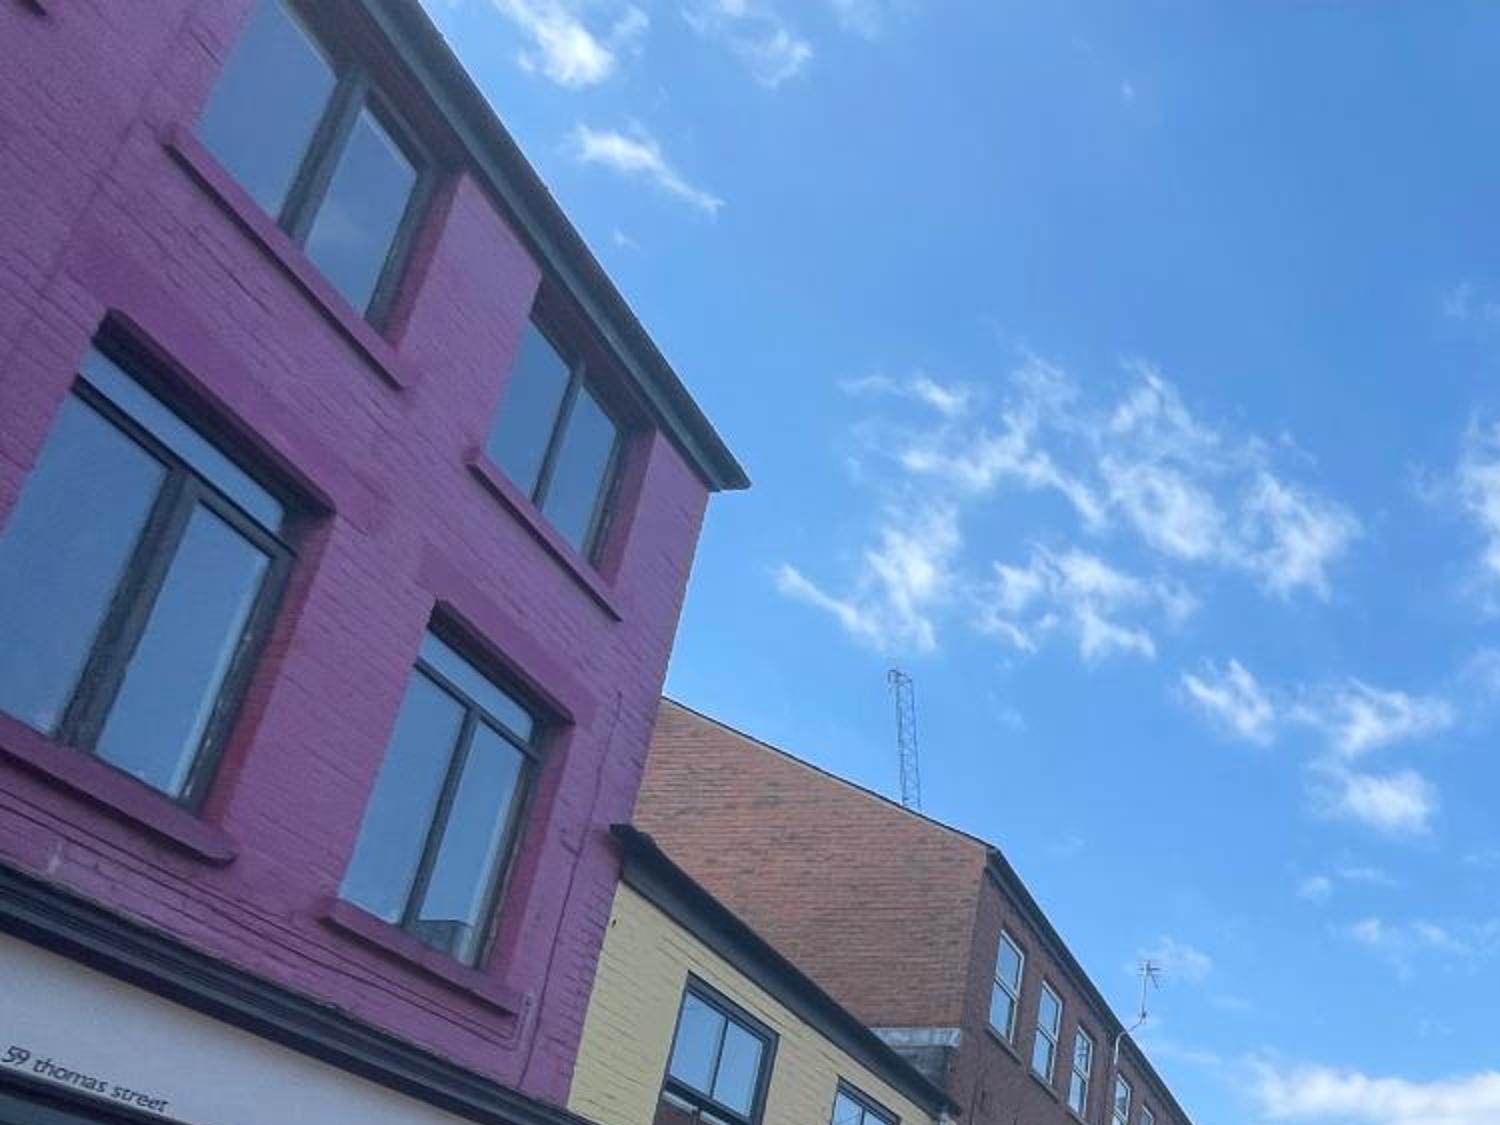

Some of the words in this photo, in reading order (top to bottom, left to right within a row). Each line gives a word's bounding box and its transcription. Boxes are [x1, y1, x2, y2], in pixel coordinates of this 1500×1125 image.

[1, 1045, 31, 1065] 59
[33, 1058, 108, 1093] thomas
[111, 1086, 169, 1113] street
